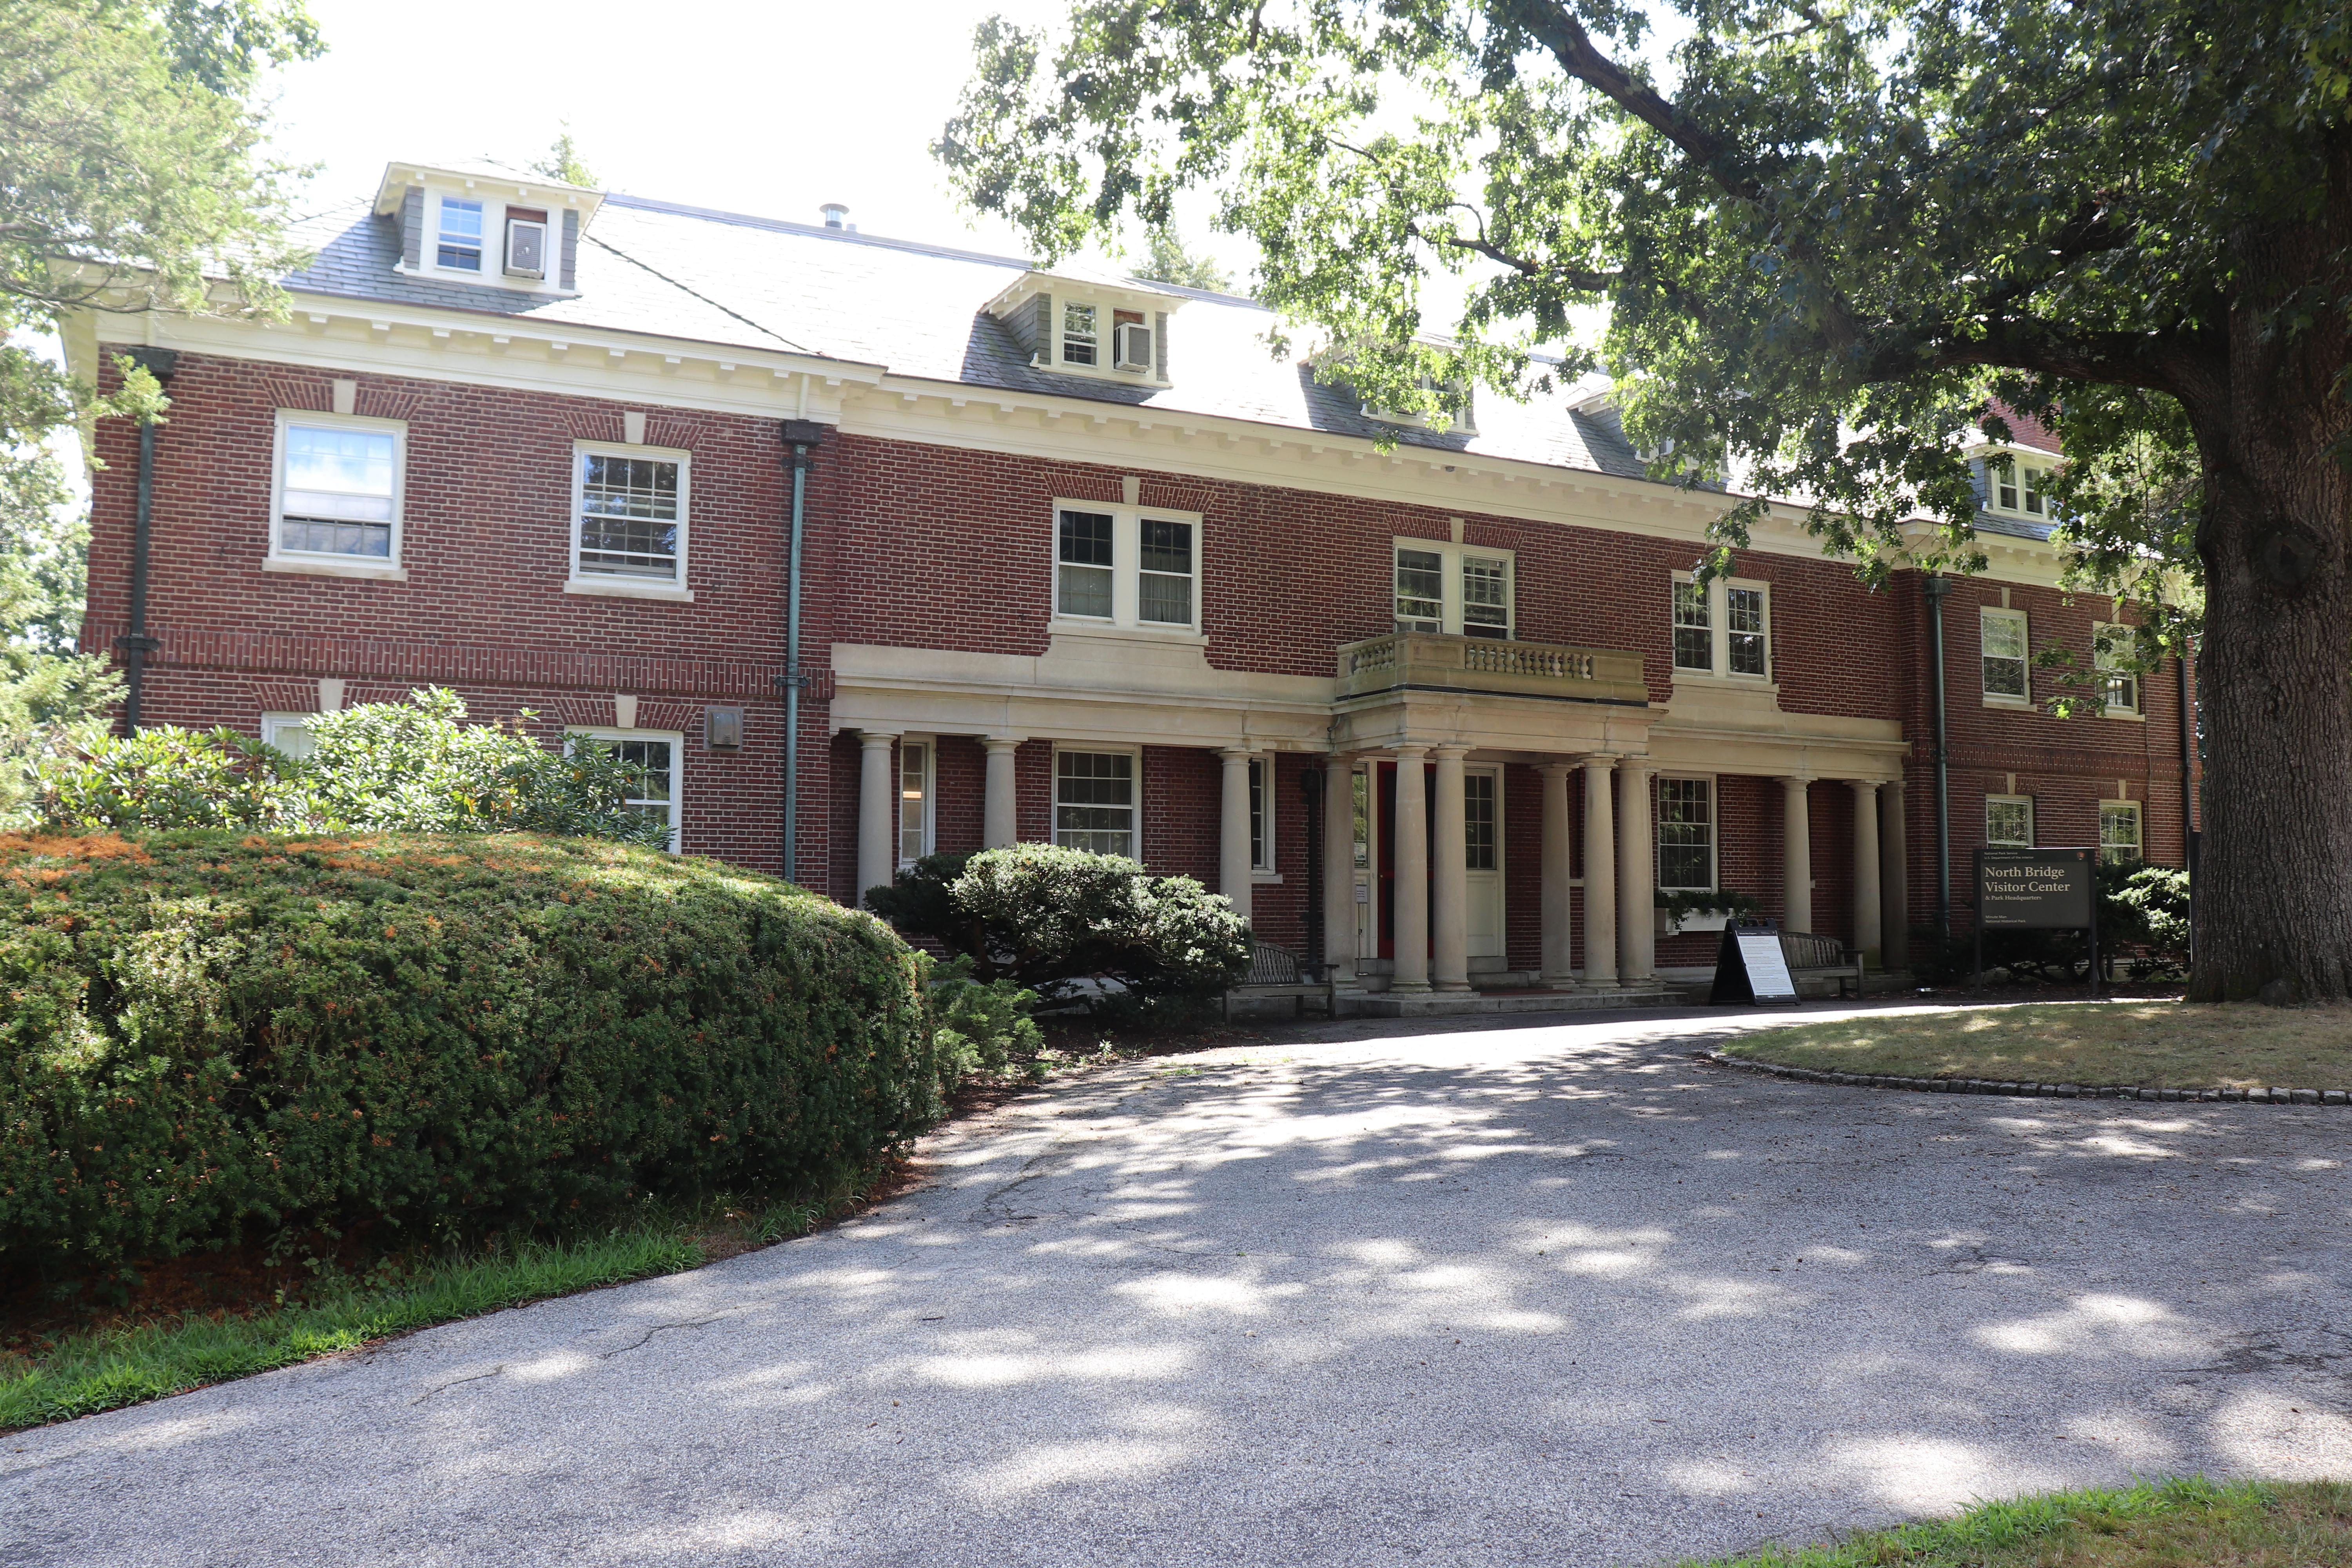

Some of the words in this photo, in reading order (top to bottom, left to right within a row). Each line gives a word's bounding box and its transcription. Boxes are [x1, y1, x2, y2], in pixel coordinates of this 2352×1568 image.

[1985, 867, 2021, 877] North
[2025, 866, 2065, 879] Bridge
[1985, 882, 2025, 892] Visitor
[2029, 881, 2070, 892] Center
